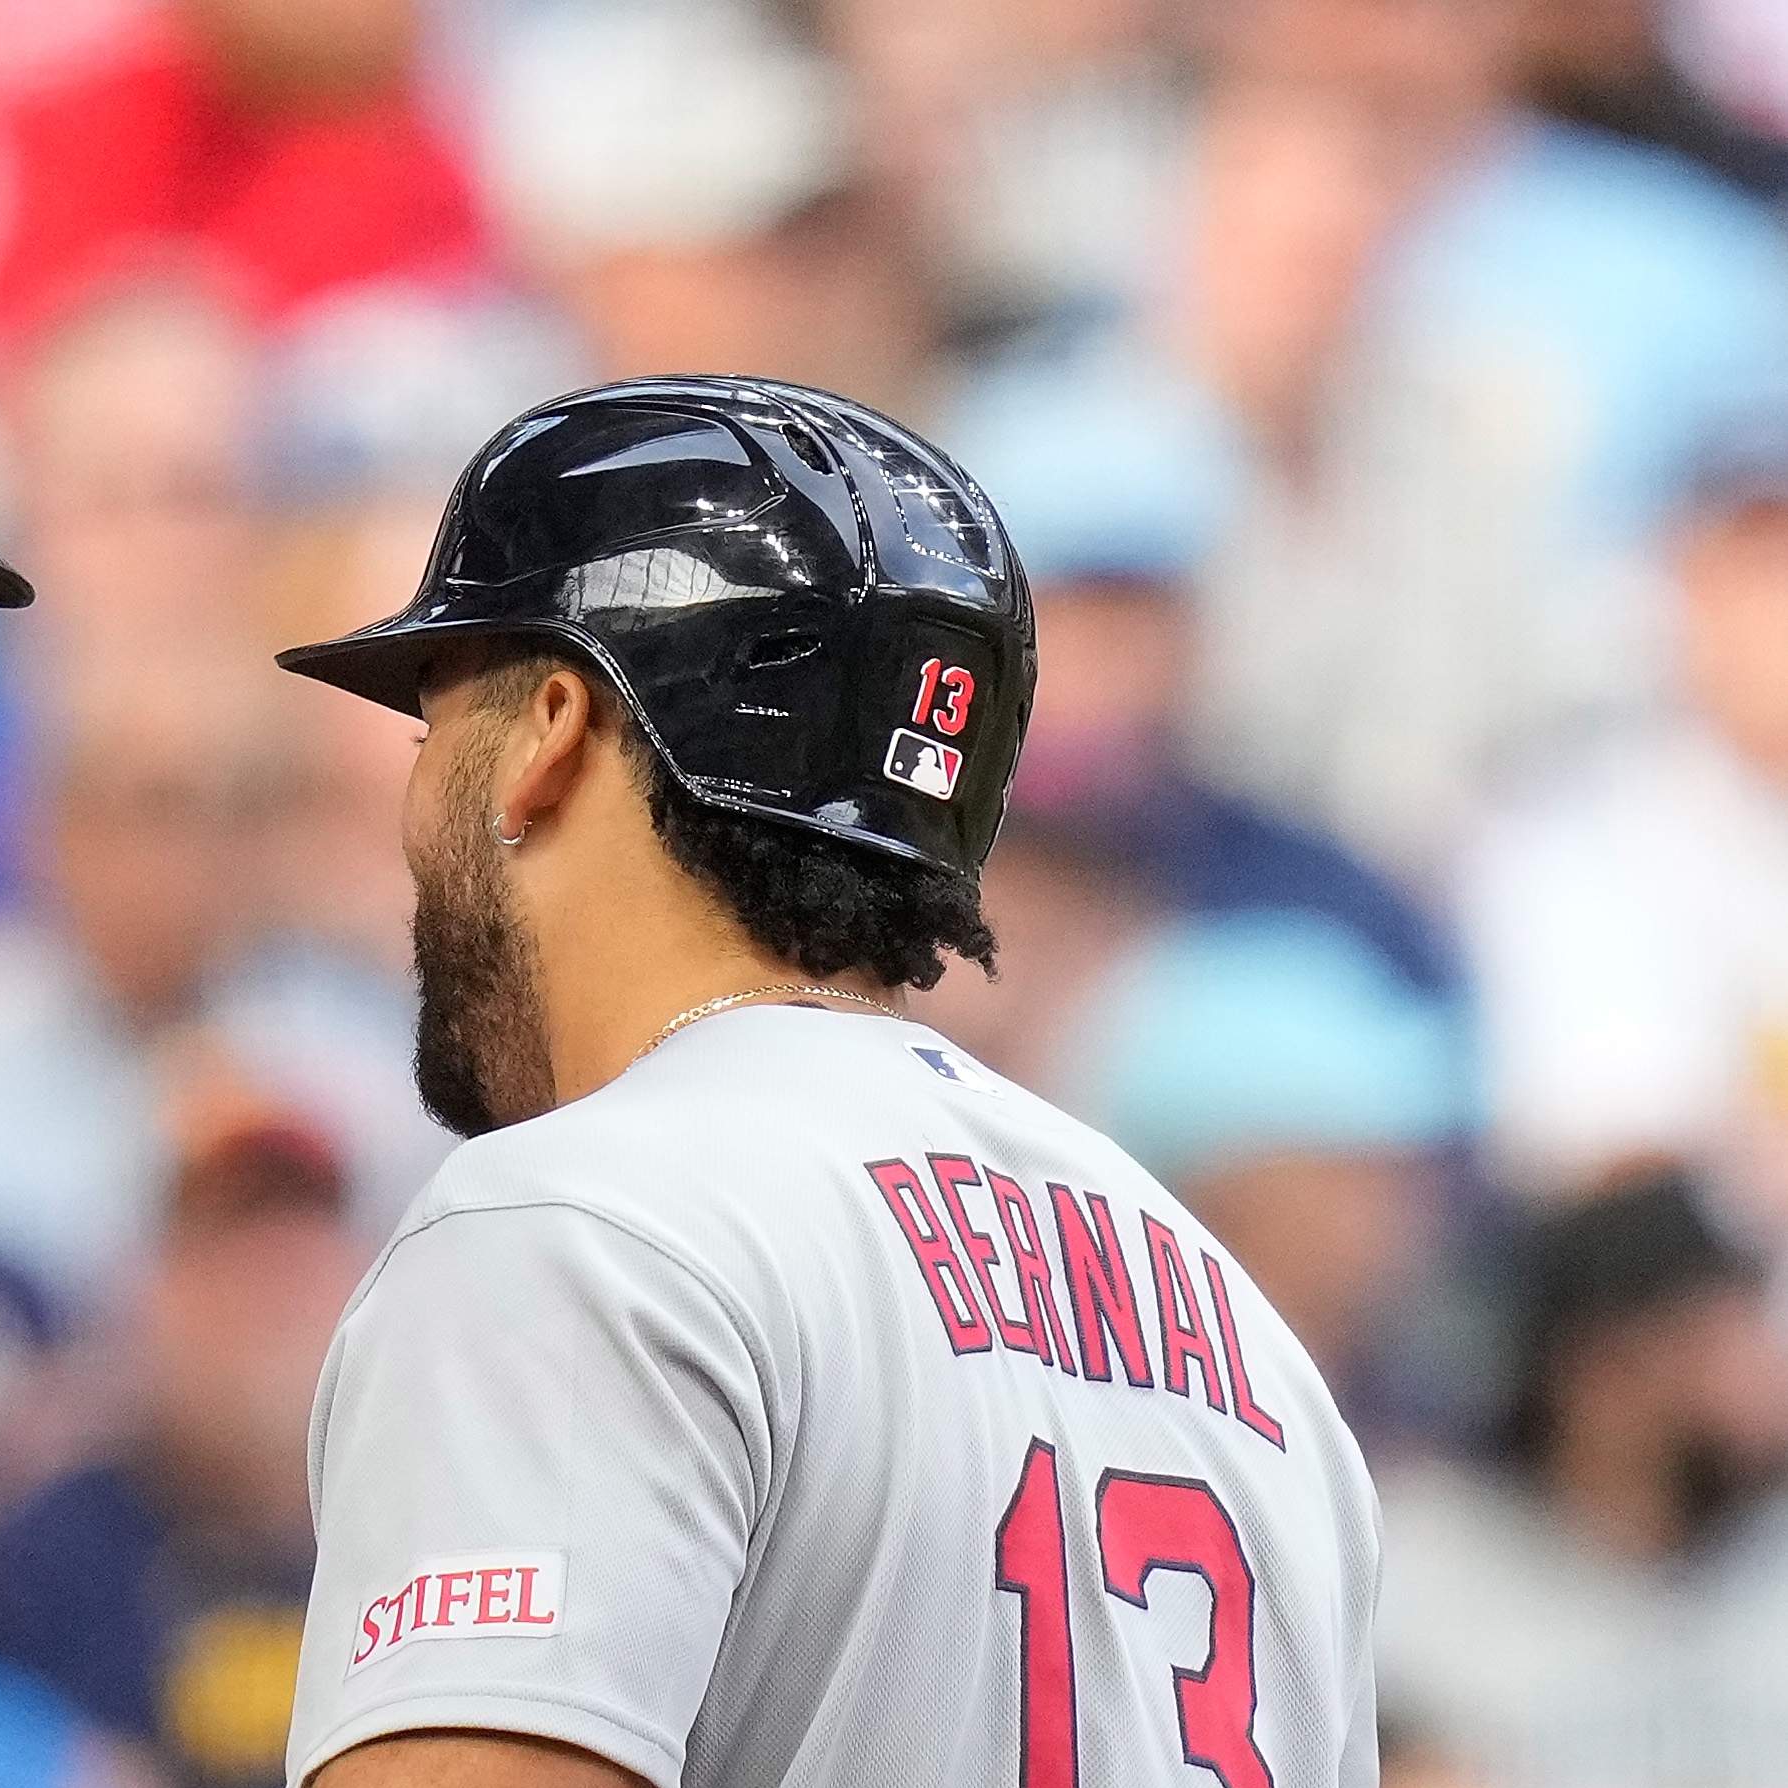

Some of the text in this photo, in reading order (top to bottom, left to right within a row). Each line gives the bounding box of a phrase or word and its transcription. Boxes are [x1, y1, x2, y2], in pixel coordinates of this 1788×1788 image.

[911, 657, 976, 736] 13
[863, 1151, 1288, 1452] BERNAL
[353, 1567, 555, 1665] STIFEL
